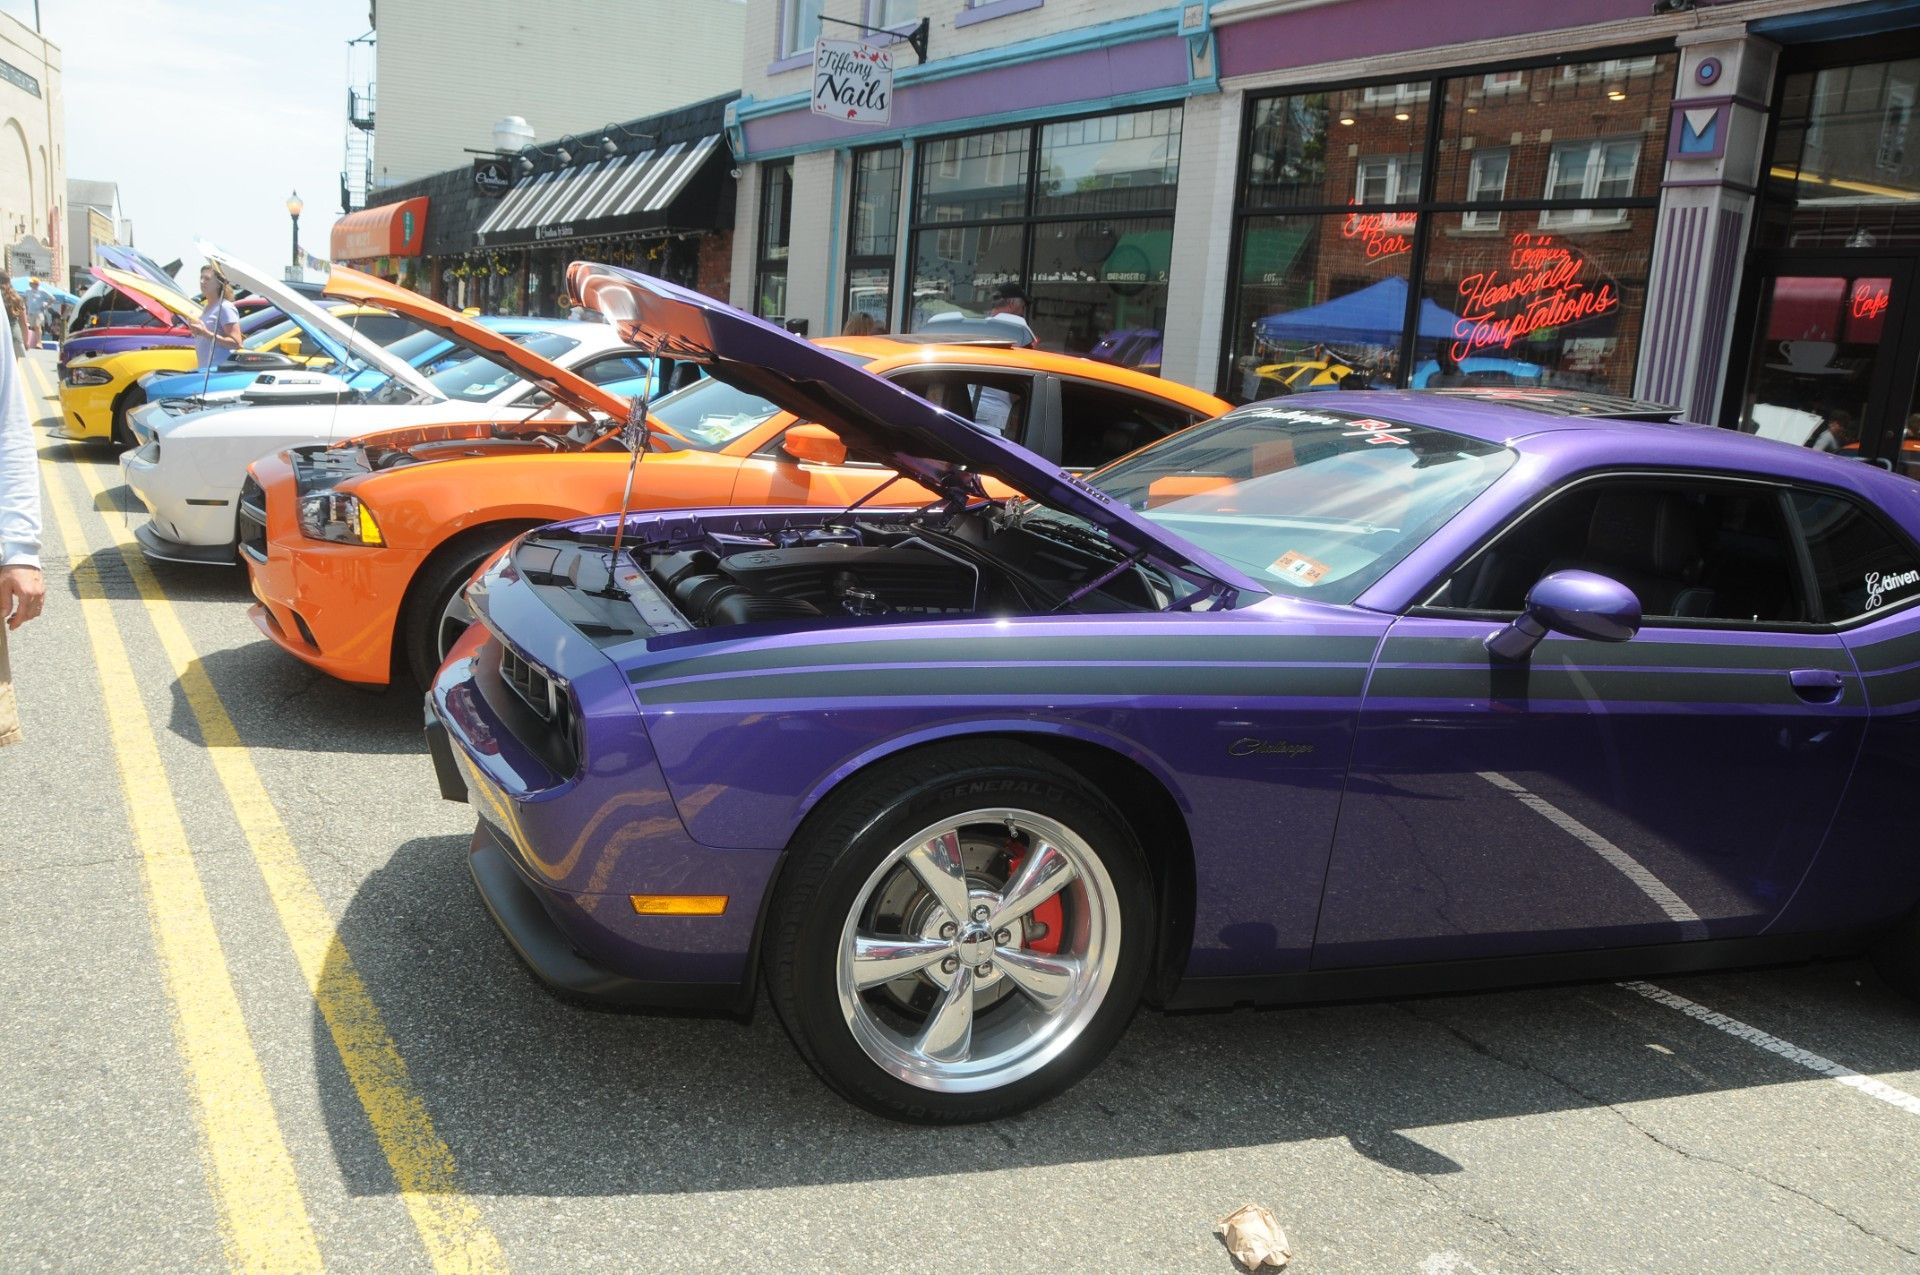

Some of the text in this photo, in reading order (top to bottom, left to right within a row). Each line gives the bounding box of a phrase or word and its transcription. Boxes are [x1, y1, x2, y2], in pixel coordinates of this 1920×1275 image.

[818, 49, 872, 80] Tiffany
[817, 73, 888, 110] Nails
[1343, 198, 1418, 241] Espress
[1366, 228, 1411, 257] Bar
[1459, 255, 1583, 317] Heavenly
[1853, 284, 1889, 319] Cafe
[1450, 285, 1618, 362] Temptations
[1341, 418, 1413, 445] R/T
[1294, 563, 1306, 572] 4
[1884, 570, 1920, 591] driven
[940, 779, 1043, 799] GENERAL
